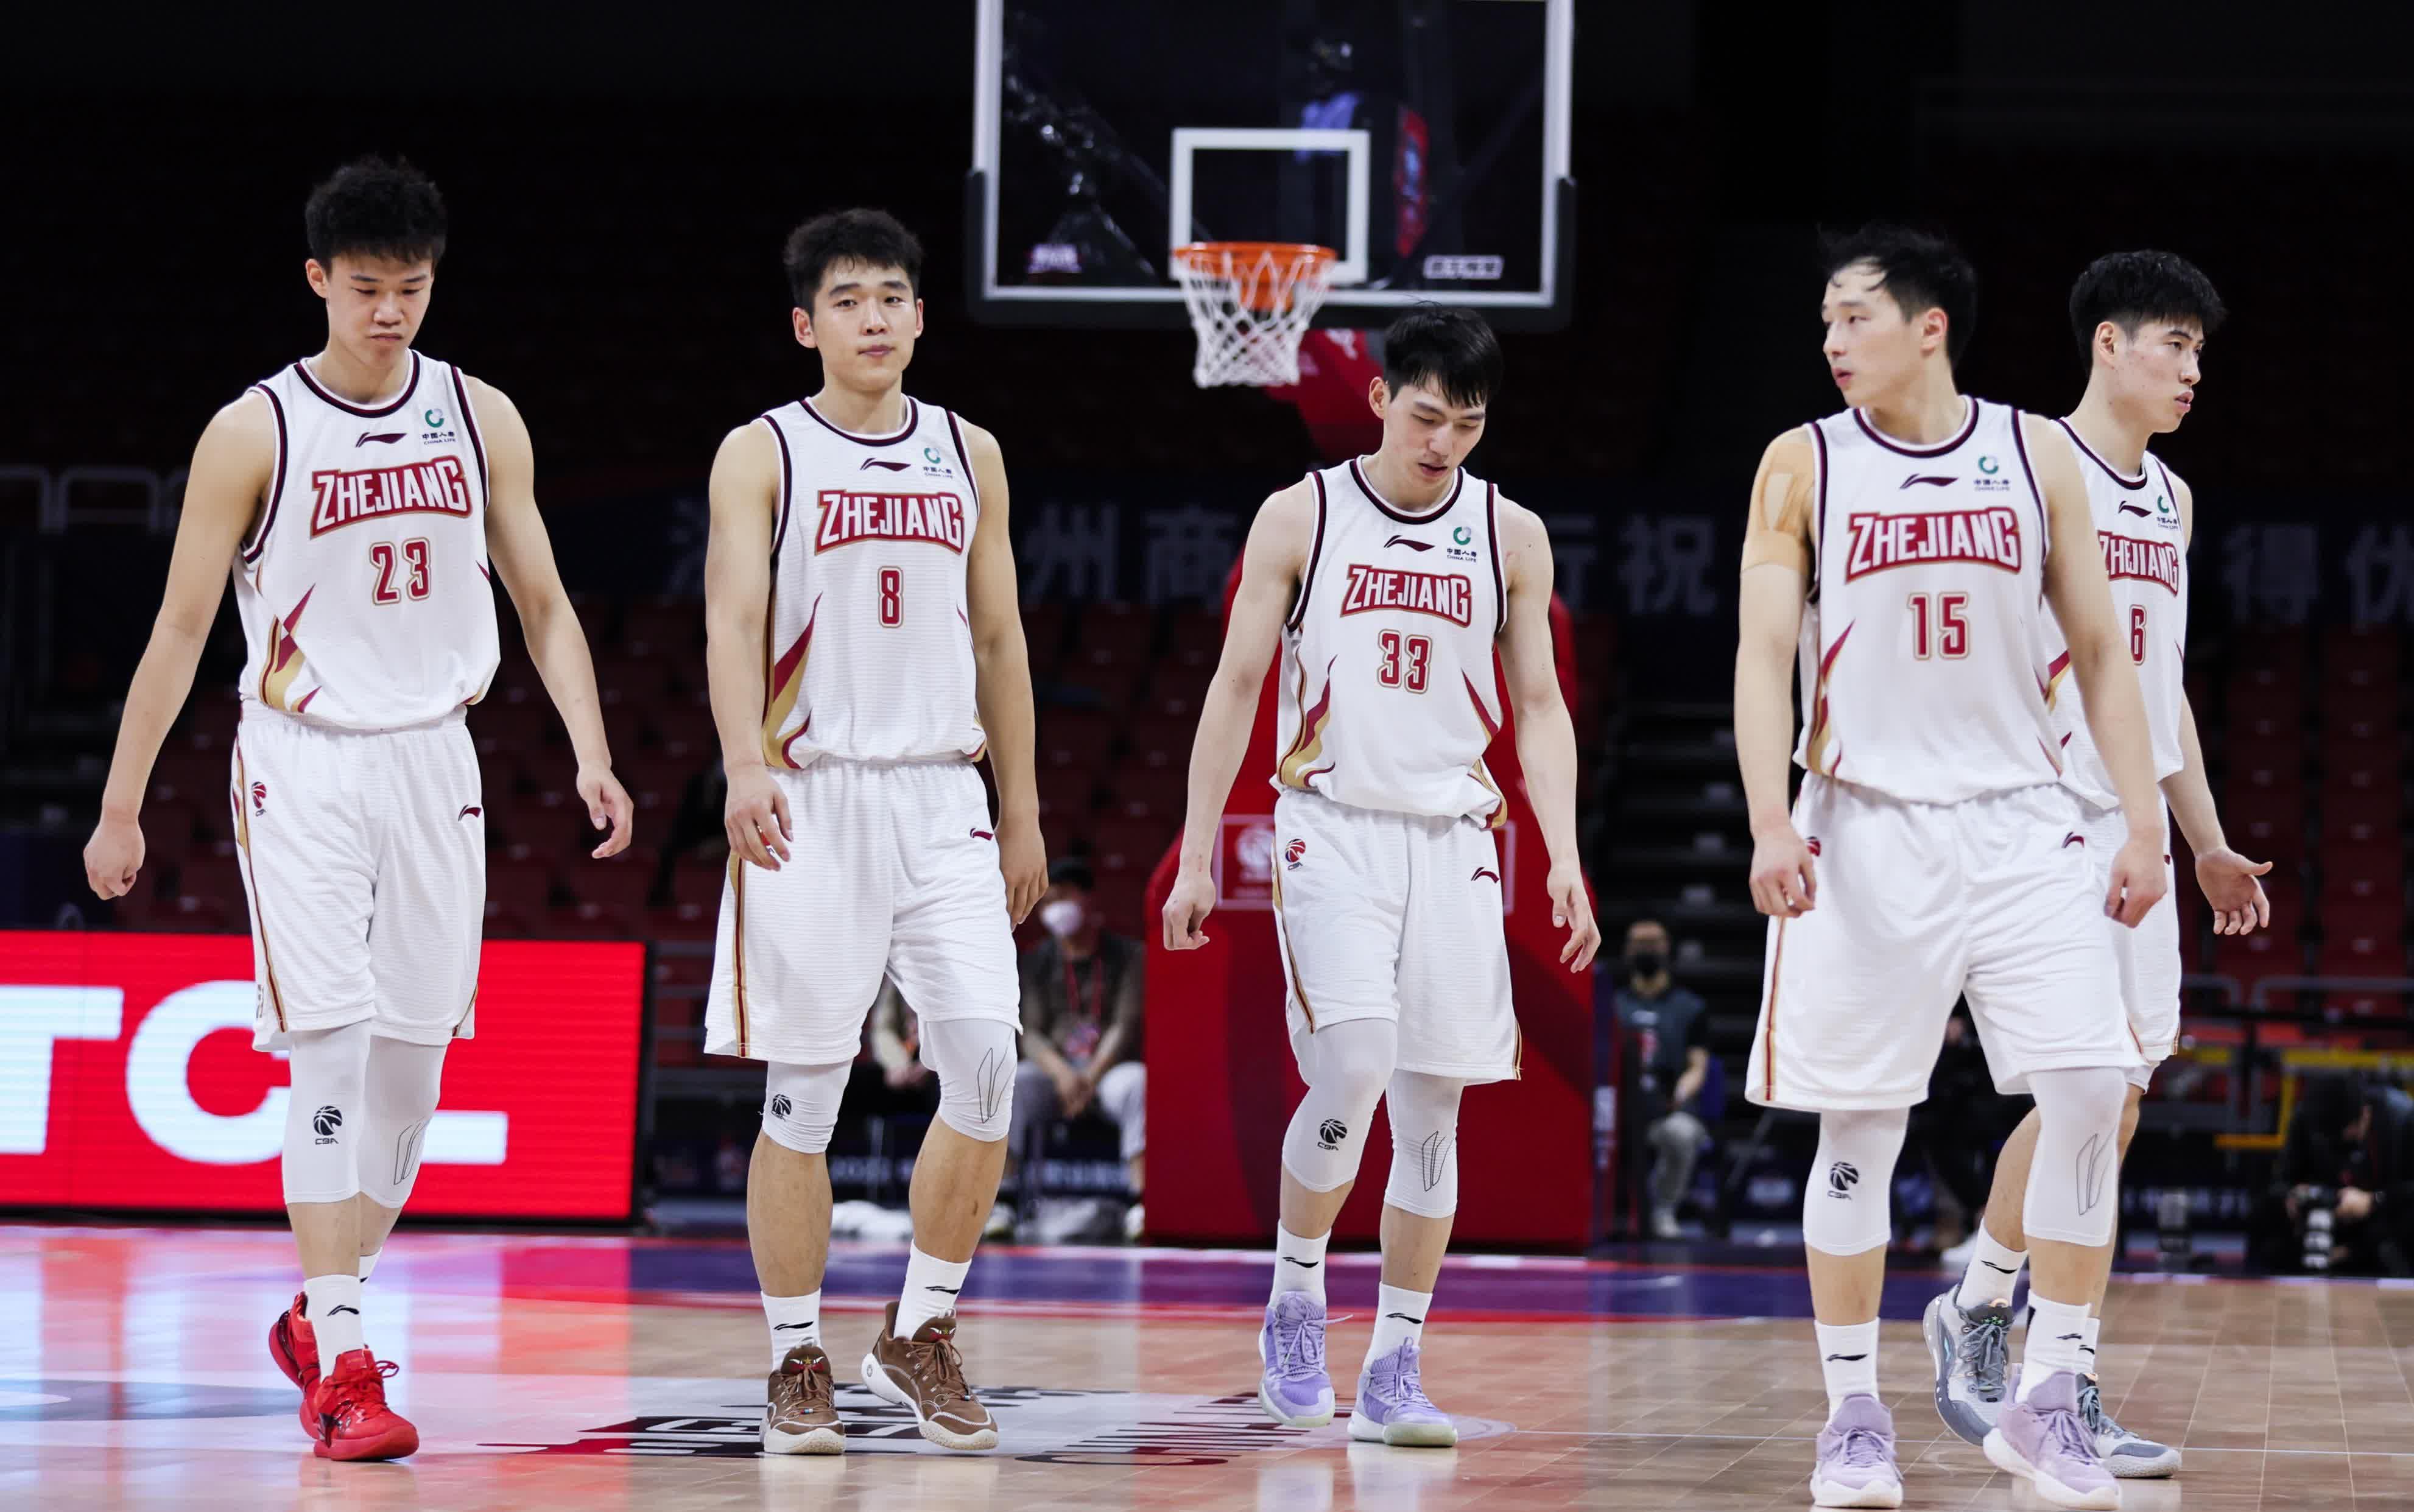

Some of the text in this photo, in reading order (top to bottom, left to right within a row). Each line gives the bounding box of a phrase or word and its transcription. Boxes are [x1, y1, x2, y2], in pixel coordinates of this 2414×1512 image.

[314, 459, 470, 534] ZHEJIANG
[818, 492, 963, 553] ZHEJIANG
[371, 537, 431, 605] 23
[1848, 509, 2020, 580] ZHEJIANG
[2098, 533, 2178, 594] ZHEJIANG
[878, 565, 904, 628] 8
[1344, 566, 1469, 626] ZHEJIANG
[1907, 592, 1969, 661] 15
[1378, 628, 1432, 694] 33
[2129, 604, 2147, 666] 6
[1317, 1141, 1339, 1150] CBA
